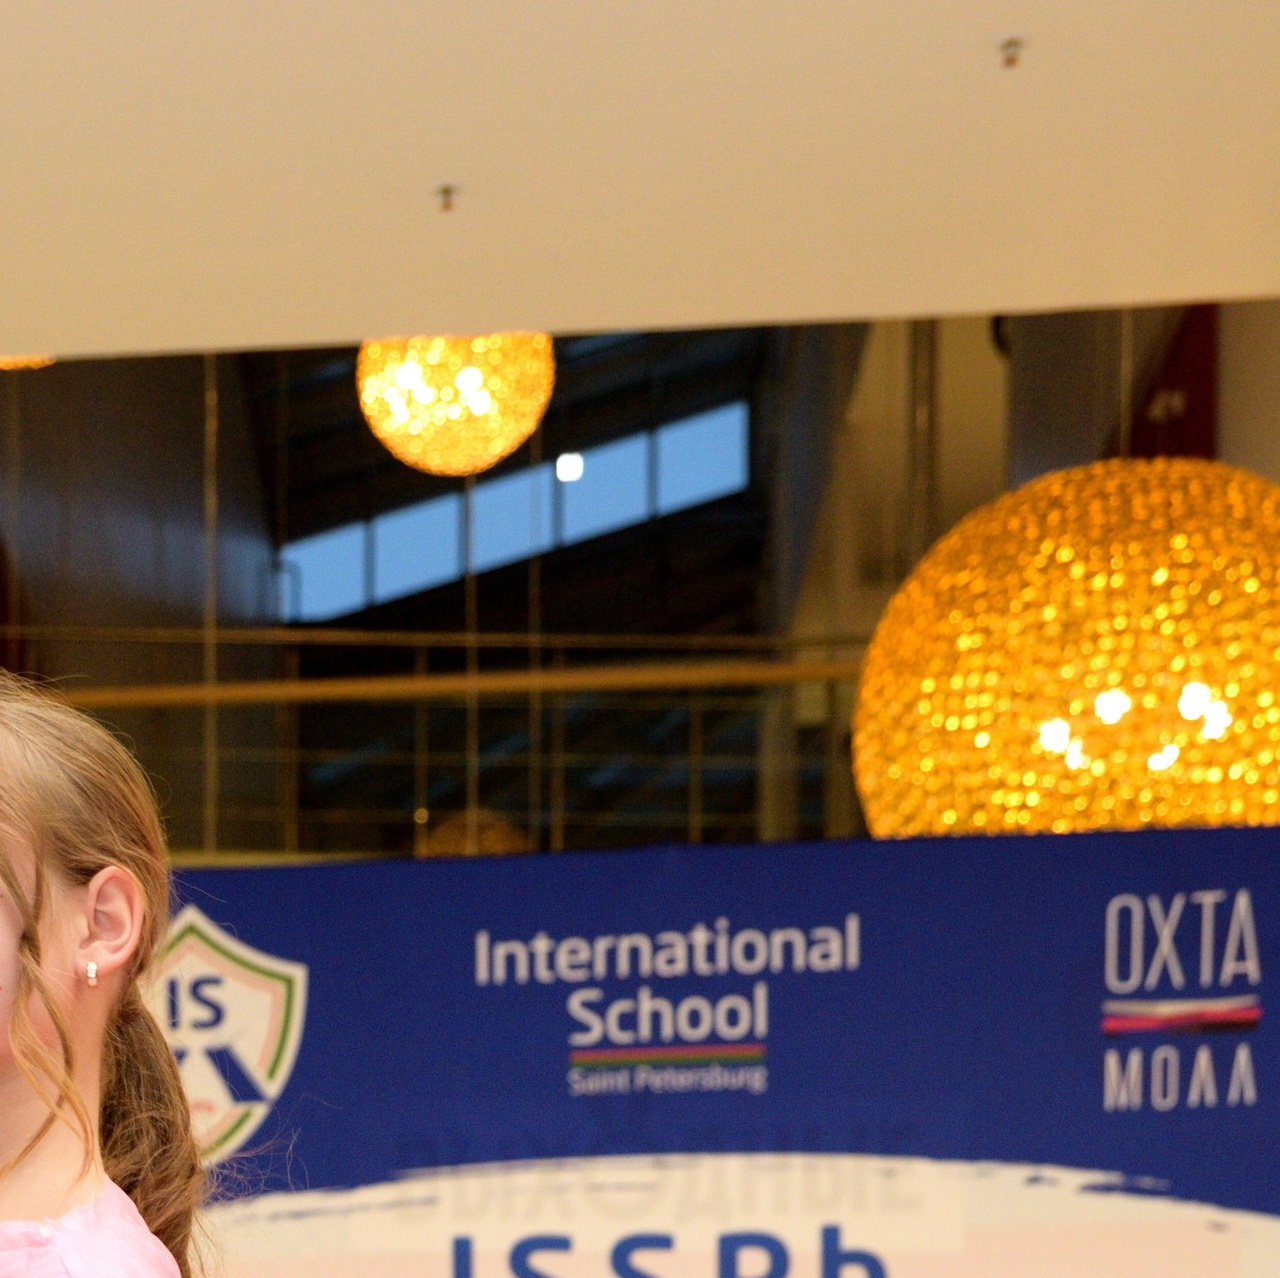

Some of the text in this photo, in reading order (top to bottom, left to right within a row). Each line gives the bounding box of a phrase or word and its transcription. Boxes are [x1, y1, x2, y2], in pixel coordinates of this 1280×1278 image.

[474, 911, 861, 987] International
[1104, 886, 1262, 995] ОХТА
[566, 981, 769, 1047] School
[566, 1066, 631, 1097] Saint
[1102, 1041, 1258, 1113] МОЛЛ
